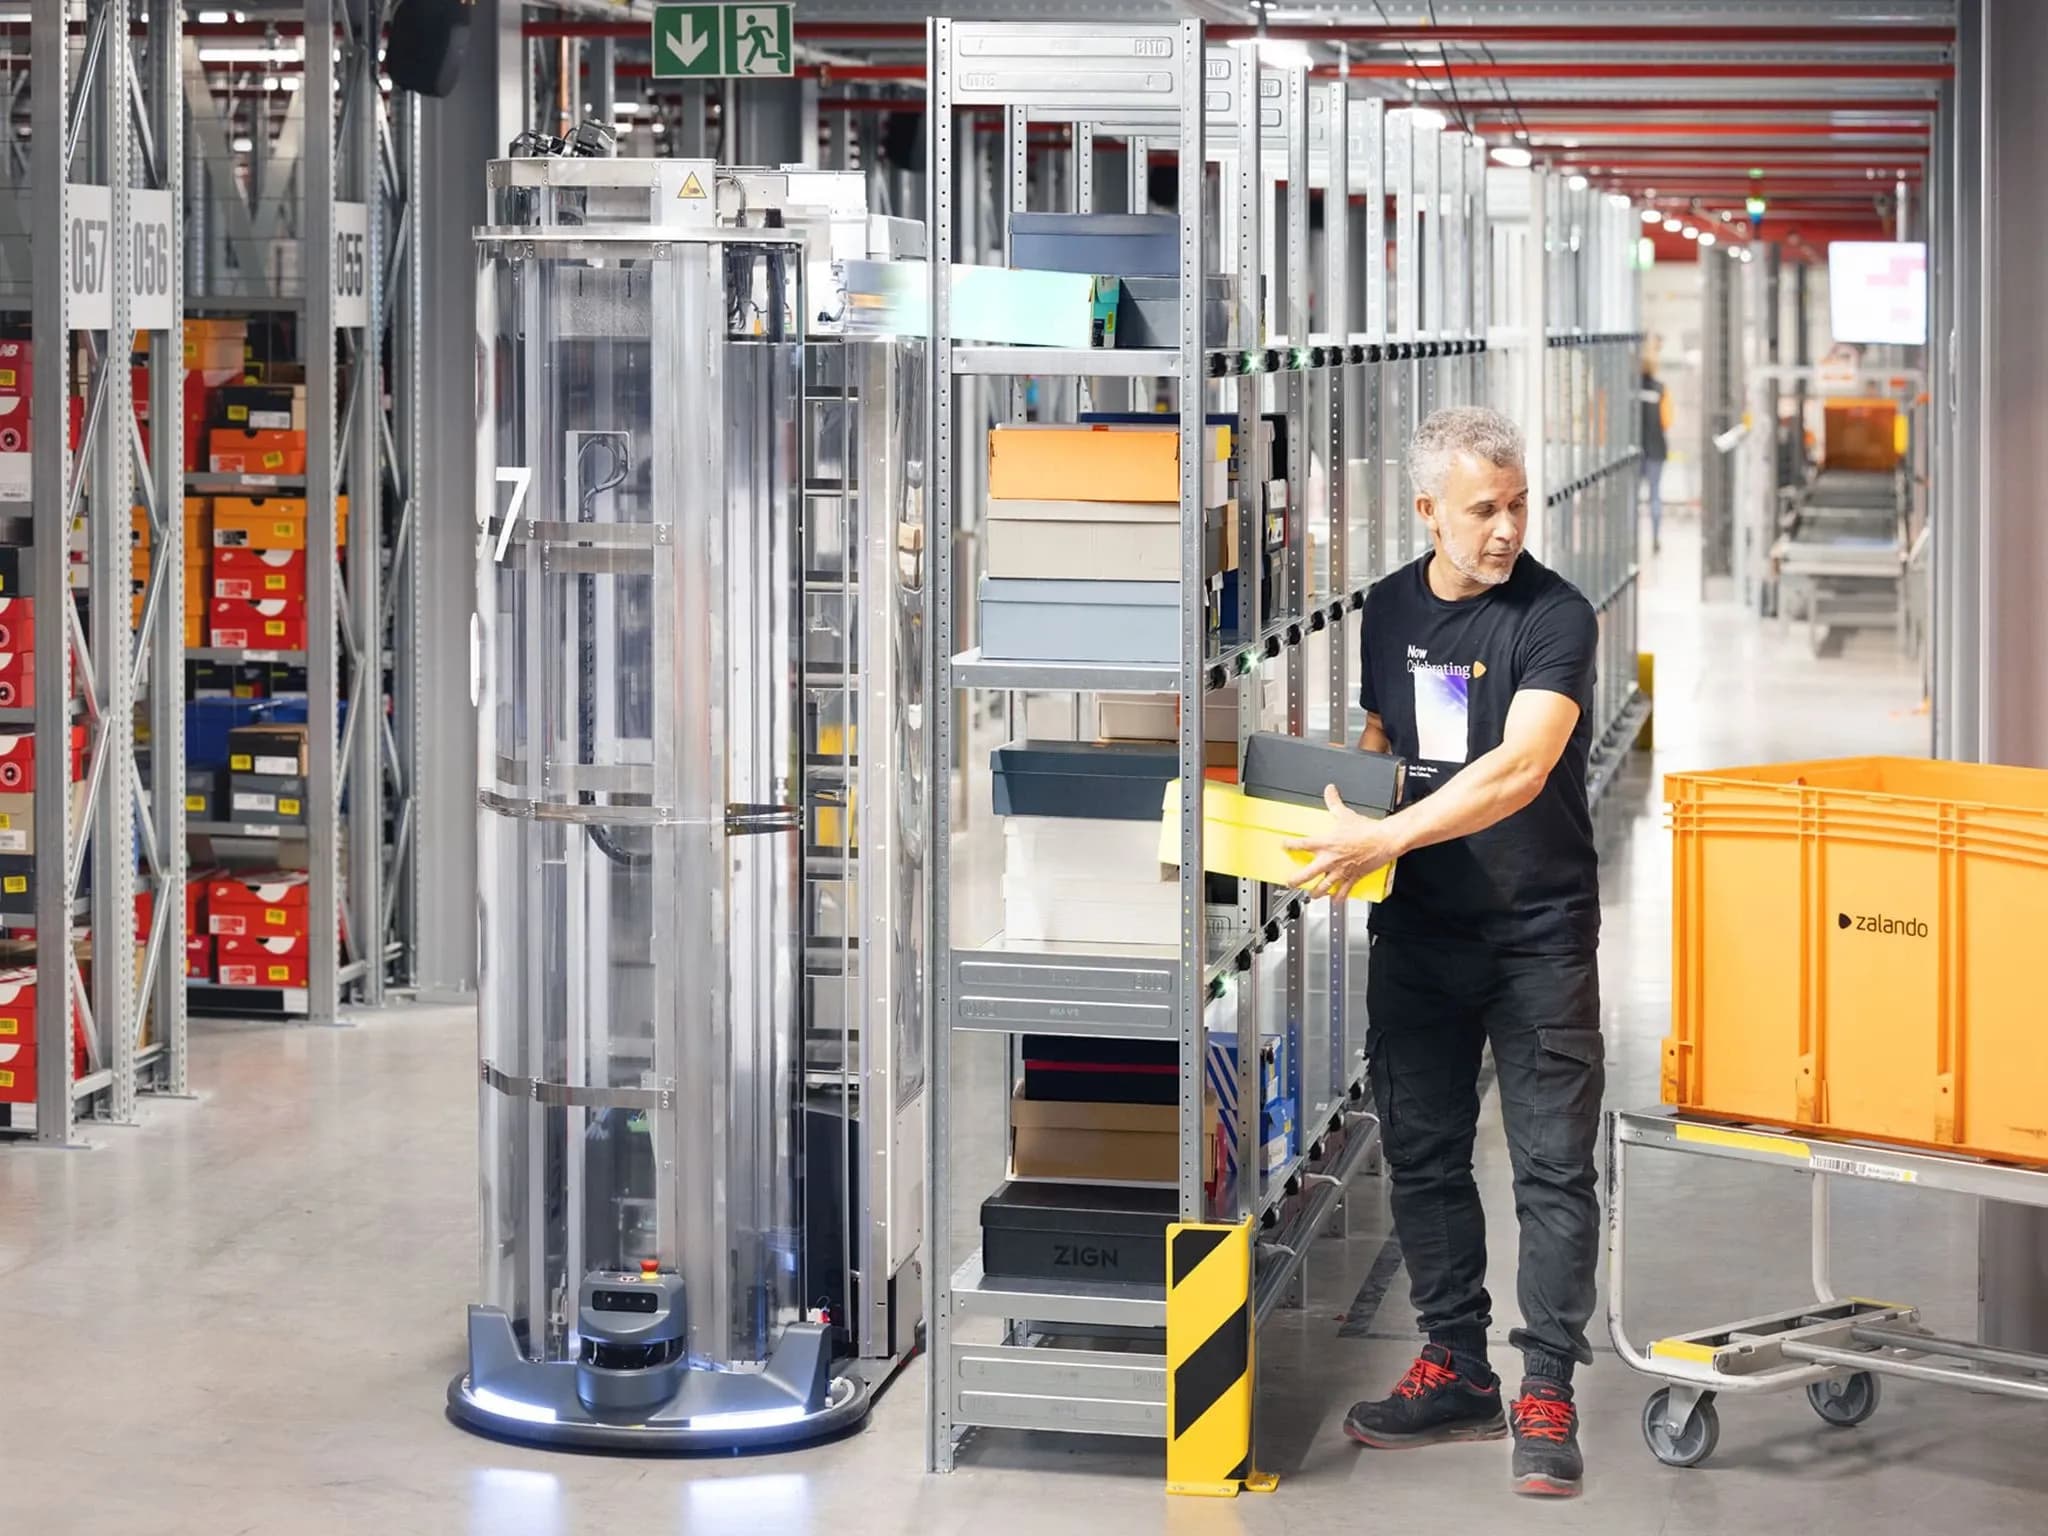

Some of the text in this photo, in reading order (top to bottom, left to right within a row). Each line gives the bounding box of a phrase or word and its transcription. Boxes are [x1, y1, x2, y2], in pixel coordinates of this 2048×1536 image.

[71, 217, 108, 294] 057
[133, 221, 168, 296] 056
[337, 231, 363, 297] 055
[1407, 644, 1428, 660] Now
[1407, 660, 1471, 679] Celebrating
[1855, 913, 1928, 938] zalando
[1053, 1245, 1118, 1269] ZIGN
